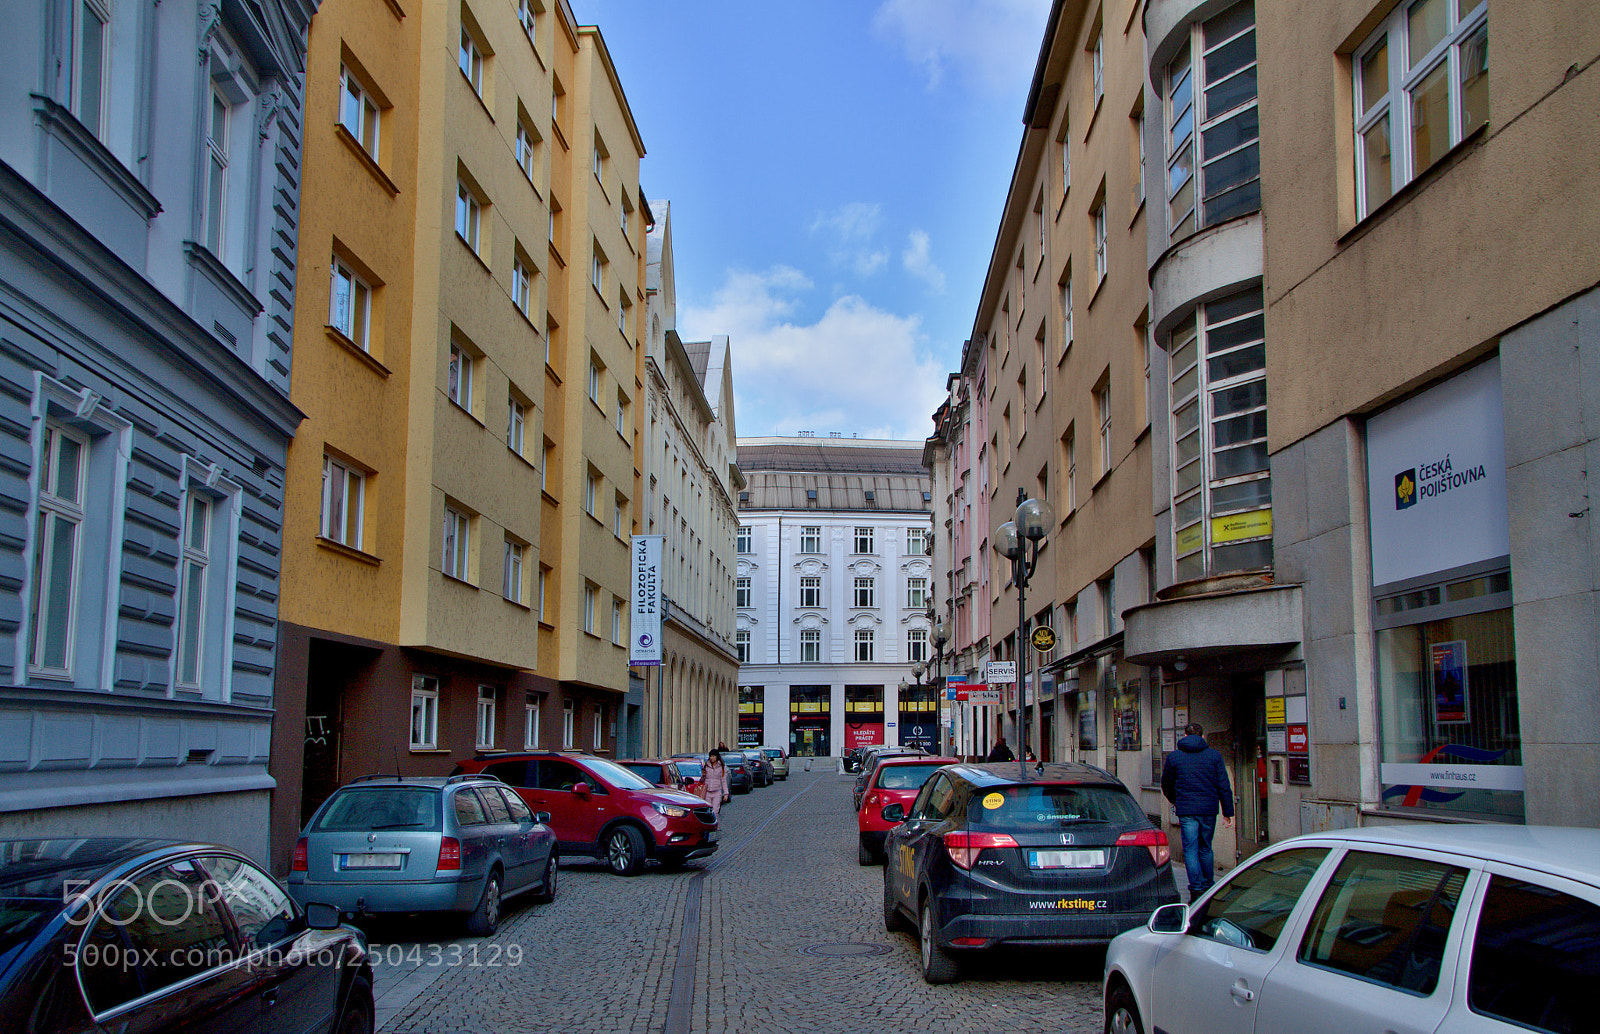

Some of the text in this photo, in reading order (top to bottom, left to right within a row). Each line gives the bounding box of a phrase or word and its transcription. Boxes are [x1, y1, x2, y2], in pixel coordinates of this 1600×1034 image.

[1419, 453, 1453, 480] ČESKÁ
[1419, 465, 1486, 499] POJIŠŤOVNA
[638, 539, 647, 614] FILOZOFICKÁ
[648, 564, 657, 615] FAKULTA
[1430, 770, 1477, 781] www.finhaus.cz
[899, 845, 915, 878] STING
[1029, 899, 1108, 910] www.rksting.cz
